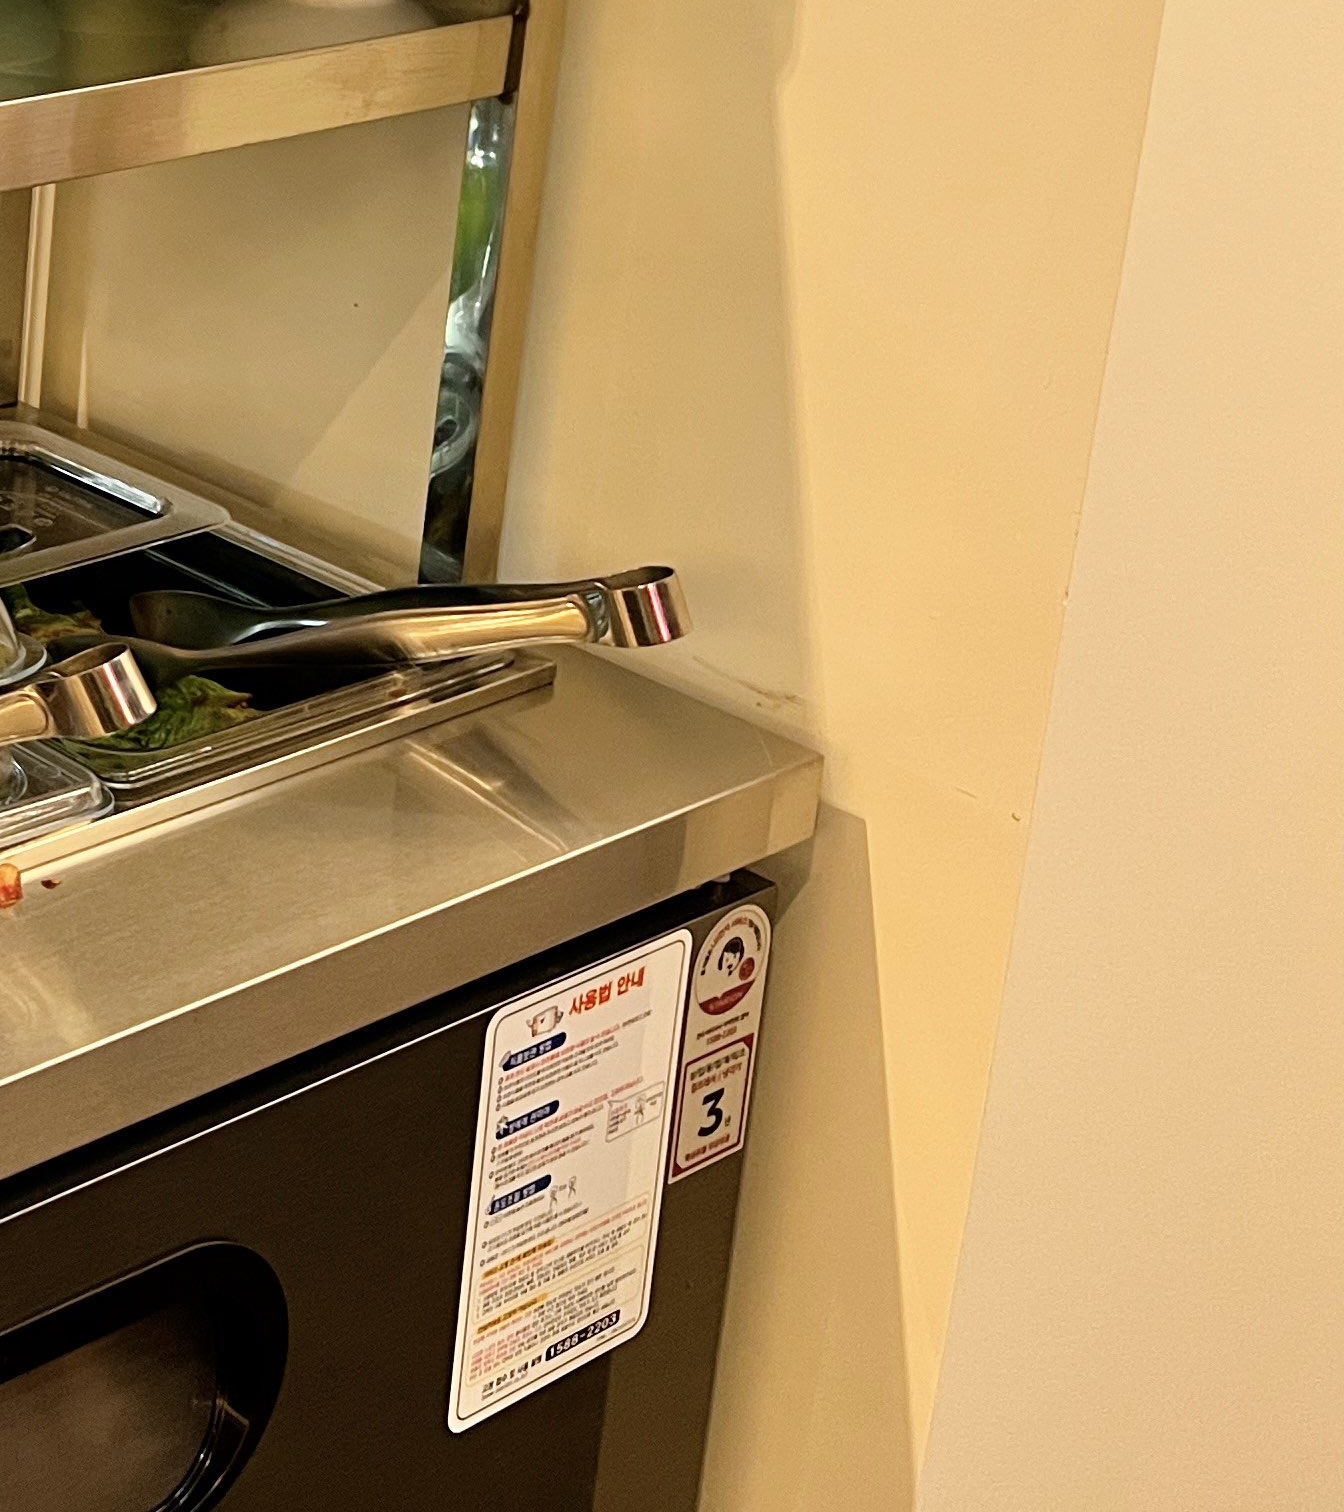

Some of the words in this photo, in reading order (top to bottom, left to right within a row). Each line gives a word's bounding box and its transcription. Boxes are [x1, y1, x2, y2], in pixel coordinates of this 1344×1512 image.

[569, 981, 613, 1016] 사용법
[617, 966, 645, 996] 안내
[698, 1088, 725, 1137] 3
[550, 1313, 617, 1357] 1588-2203
